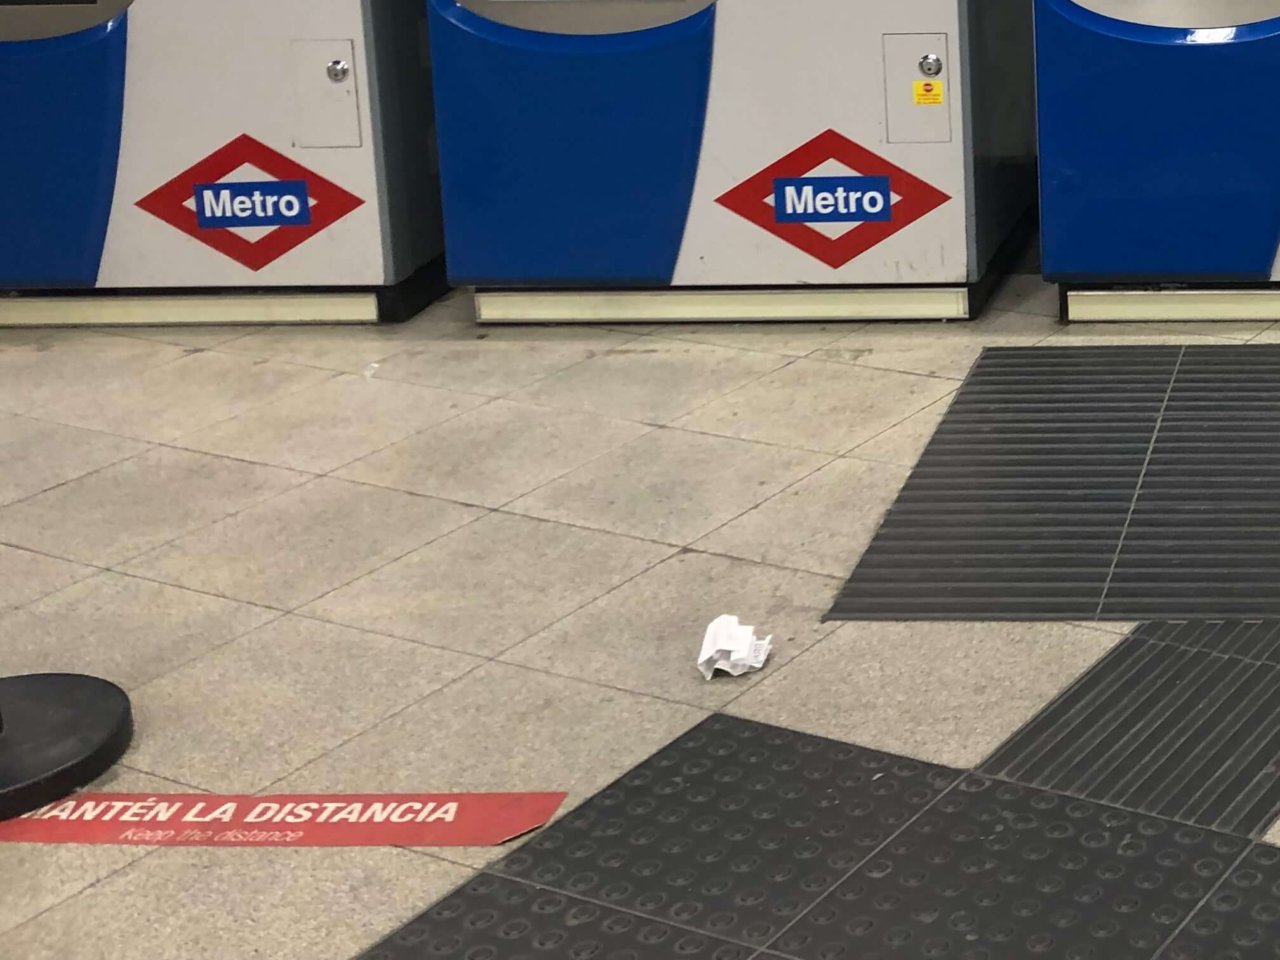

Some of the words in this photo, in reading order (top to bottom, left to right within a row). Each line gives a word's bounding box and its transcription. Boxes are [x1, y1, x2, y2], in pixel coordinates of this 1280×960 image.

[202, 189, 299, 218] Metro
[785, 185, 884, 214] Metro
[181, 802, 237, 822] LA
[243, 801, 459, 823] DISTANCIA
[118, 827, 175, 843] Keep
[176, 829, 213, 841] the
[214, 828, 304, 842] distance
